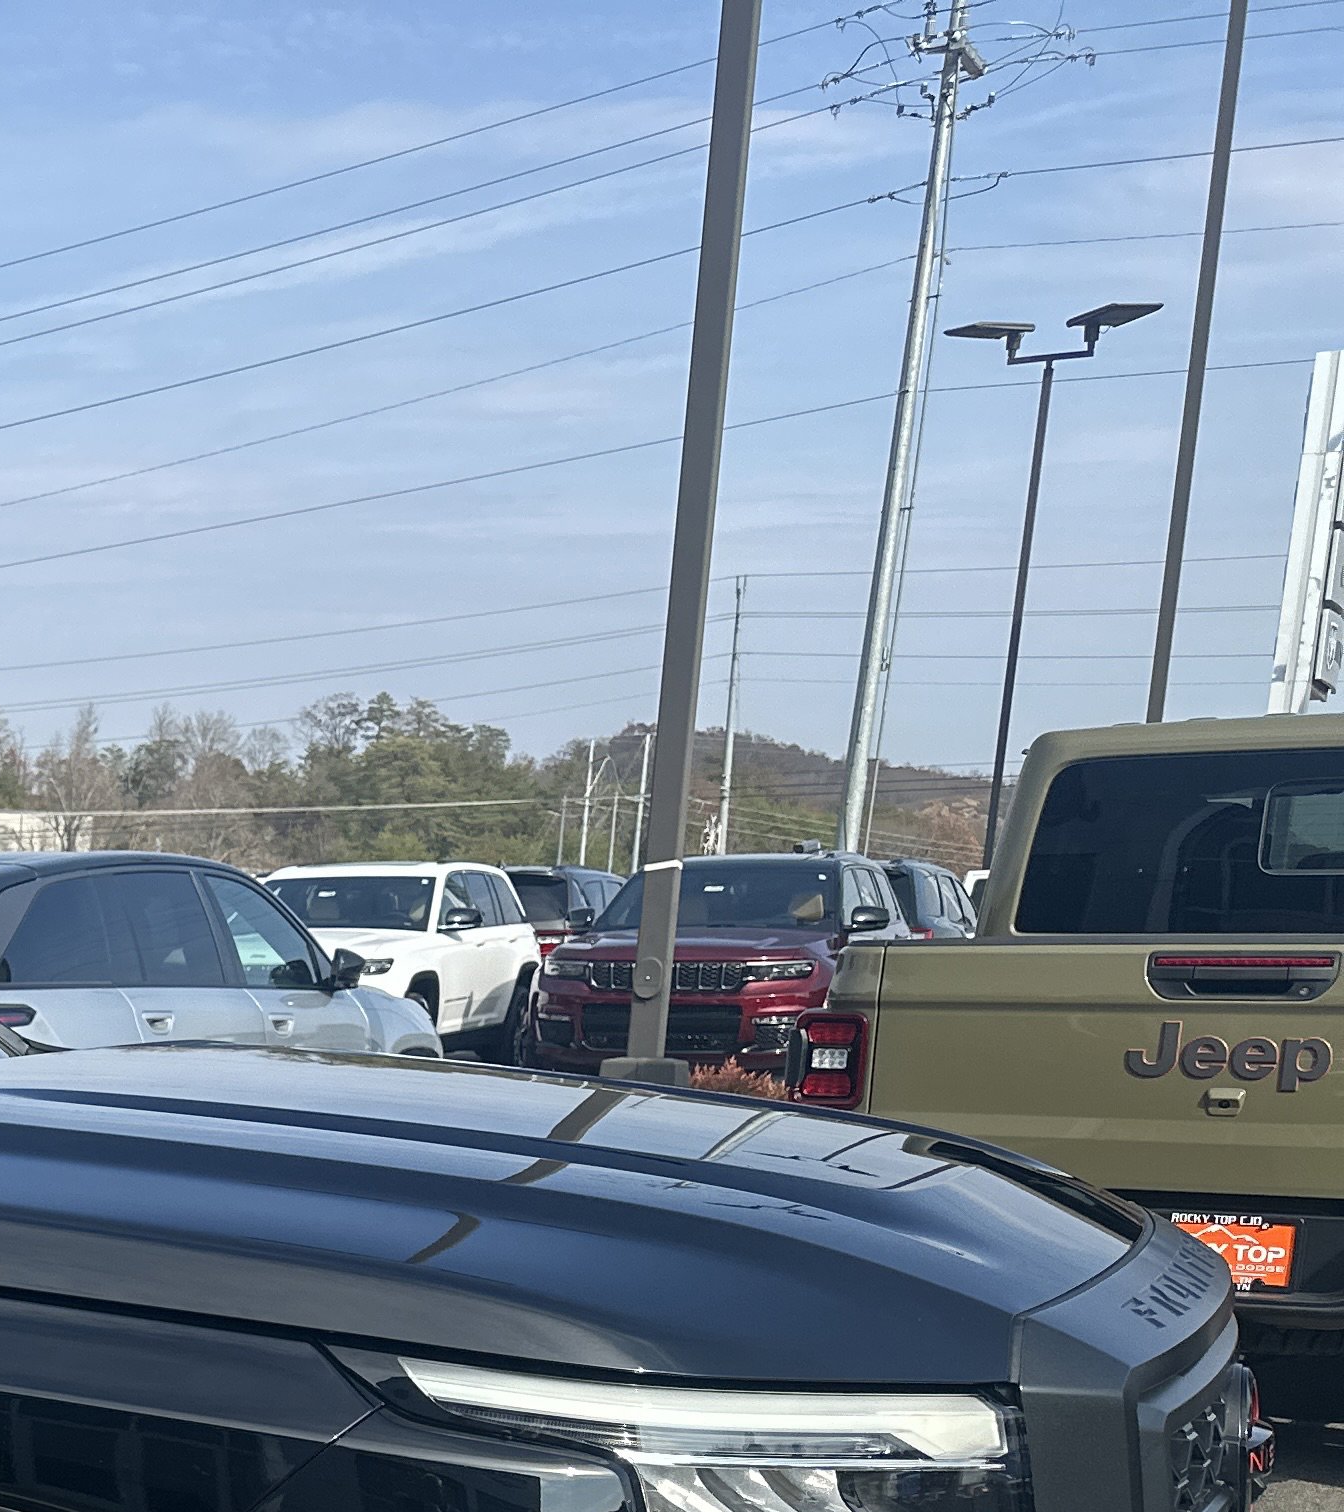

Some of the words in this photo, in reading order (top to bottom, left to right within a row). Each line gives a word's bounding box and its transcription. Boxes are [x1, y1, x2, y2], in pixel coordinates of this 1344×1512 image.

[1123, 1019, 1334, 1093] Jeep
[1171, 1212, 1211, 1223] ROCKY
[1213, 1214, 1237, 1225] TOP
[1232, 1244, 1286, 1263] TOP
